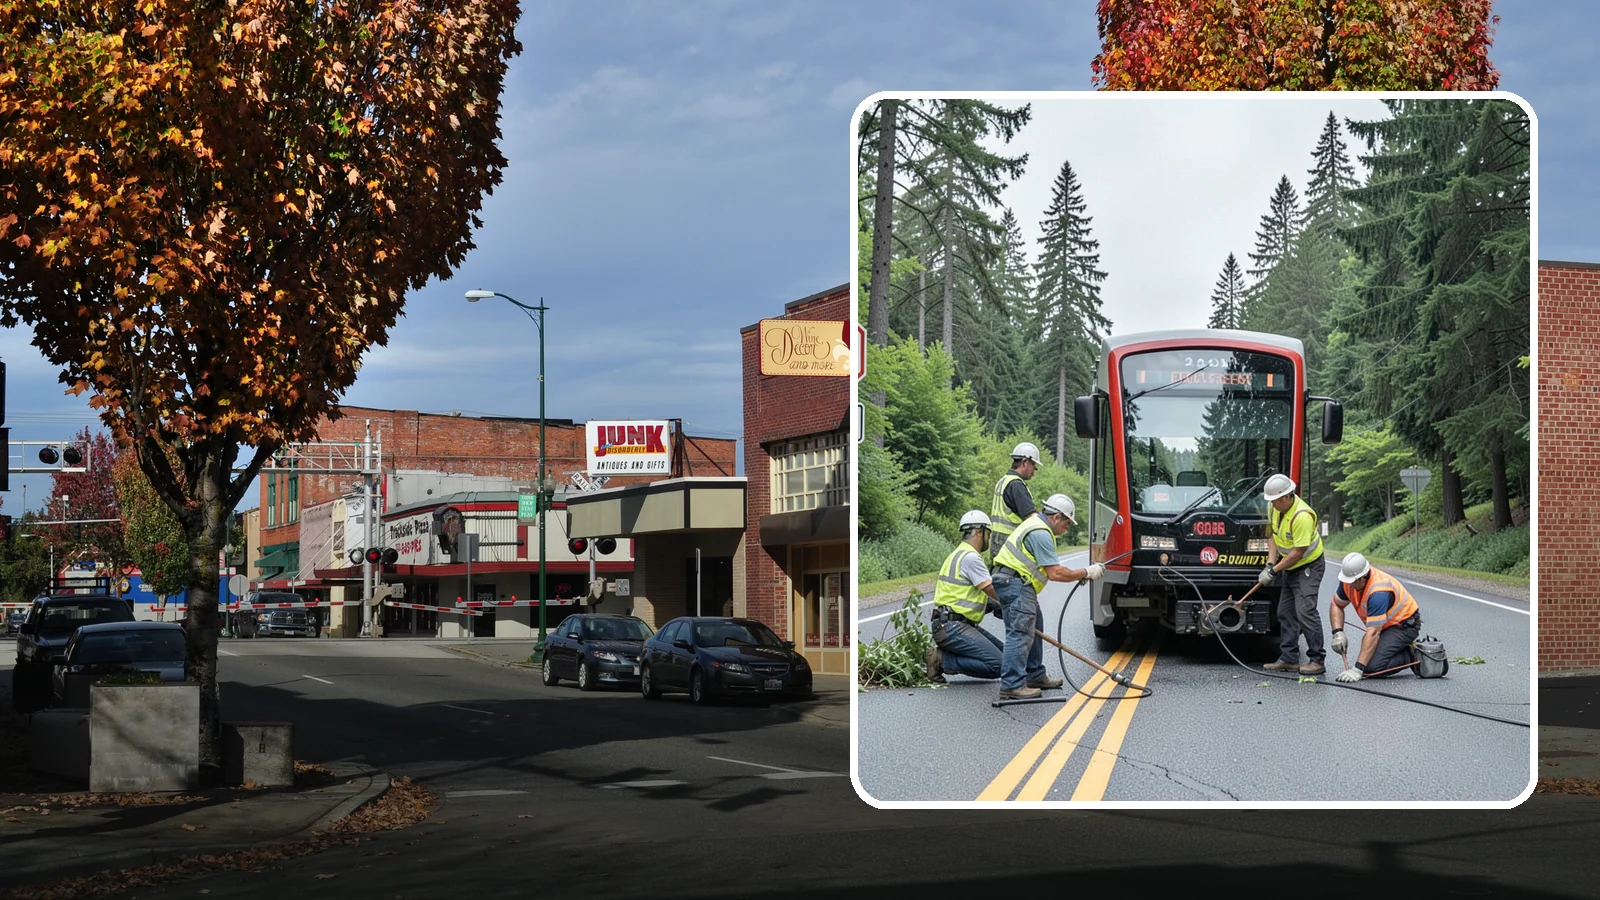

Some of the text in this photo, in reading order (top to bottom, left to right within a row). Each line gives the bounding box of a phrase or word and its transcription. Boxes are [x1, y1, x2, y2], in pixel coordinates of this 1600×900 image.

[595, 425, 665, 457] JUNK
[607, 446, 646, 454] DISORDERLY
[597, 460, 665, 470] ANTIQUES AND GIFTS
[572, 473, 589, 492] RAIL
[590, 476, 608, 492] SING
[390, 519, 429, 540] Trackside Pizza
